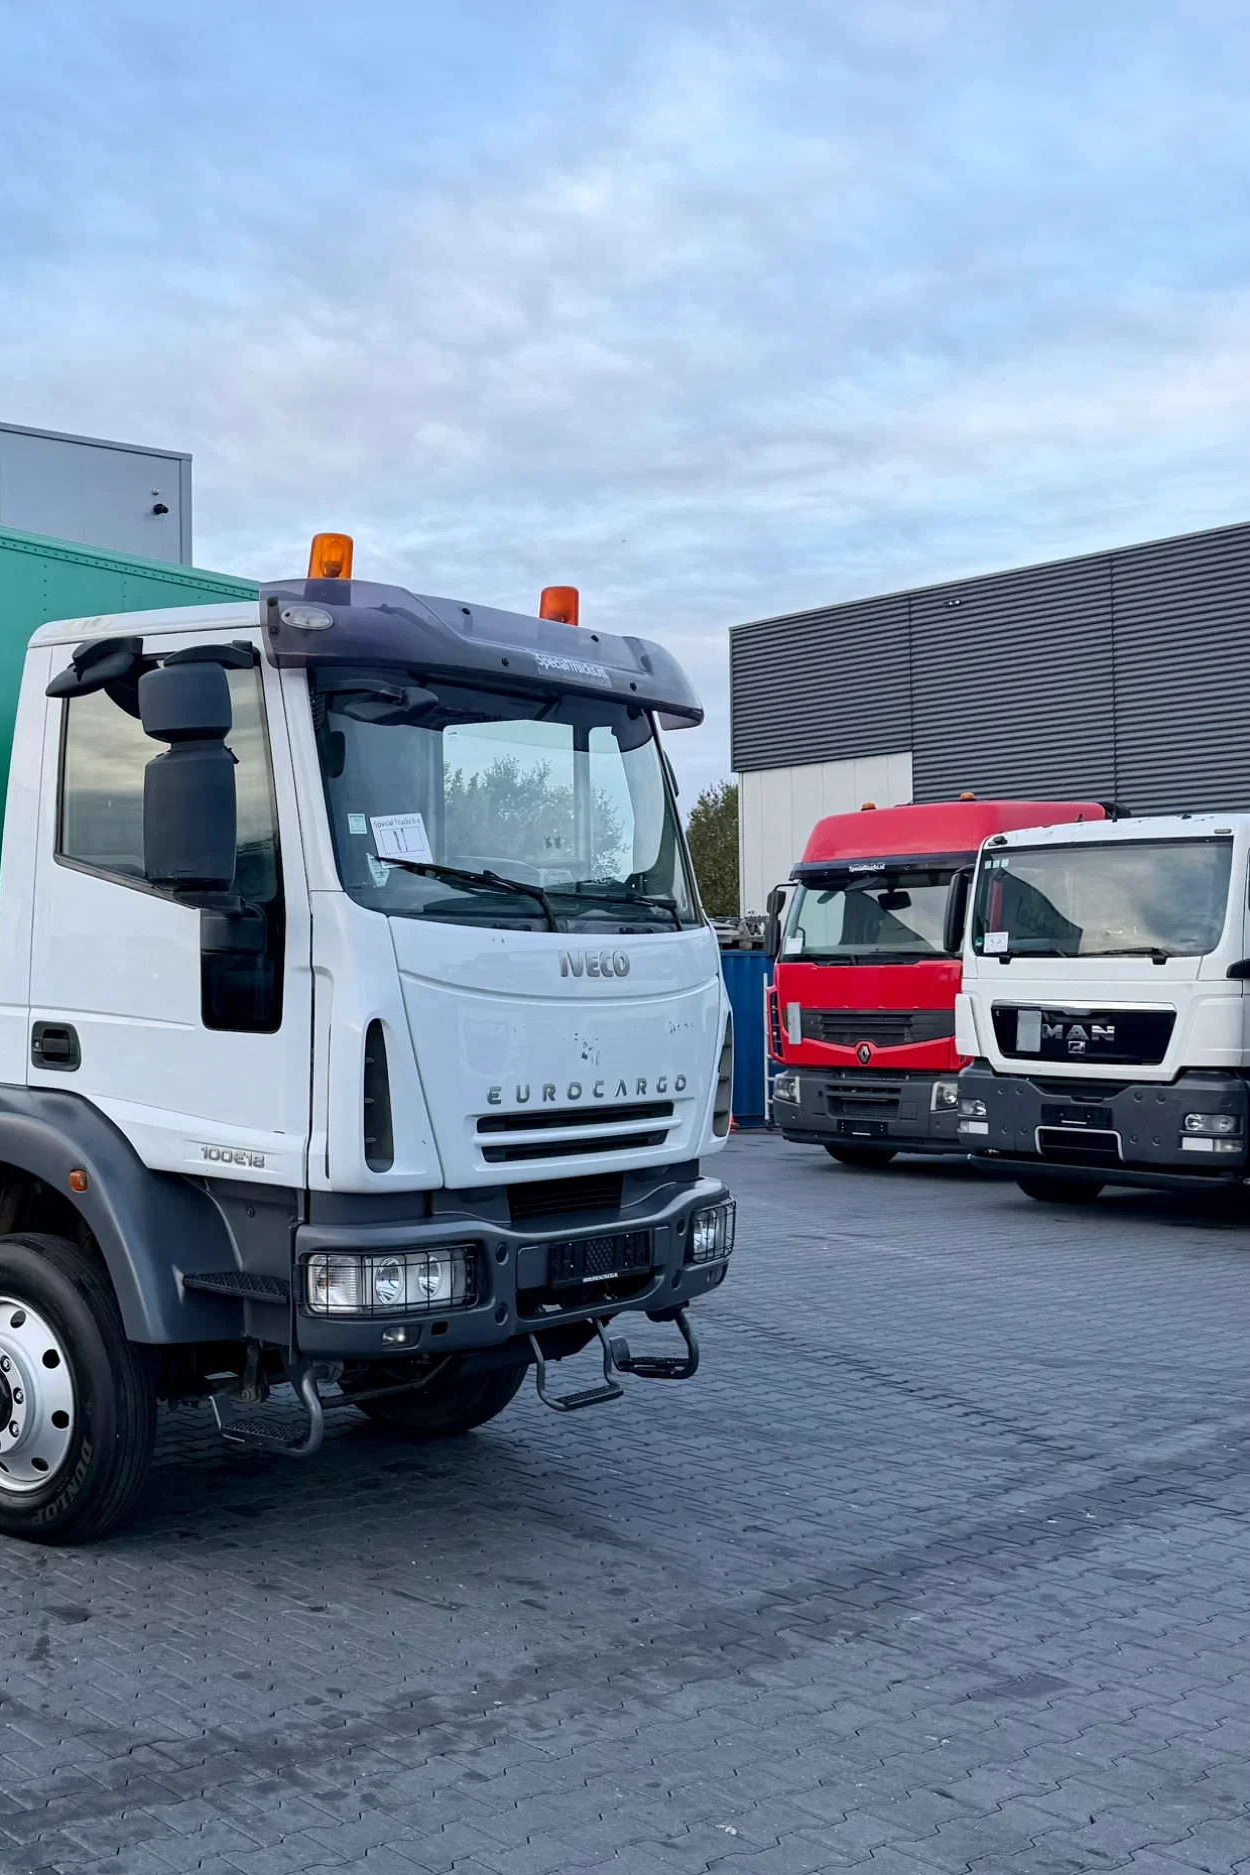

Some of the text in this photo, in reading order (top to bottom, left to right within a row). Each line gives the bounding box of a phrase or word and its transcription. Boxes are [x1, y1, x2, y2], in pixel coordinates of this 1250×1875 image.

[558, 950, 631, 978] IVECO
[1041, 1023, 1116, 1042] MAN
[486, 1074, 687, 1105] EUROCARGO
[201, 1146, 265, 1168] 100E18
[29, 1435, 94, 1527] DUNLOP
